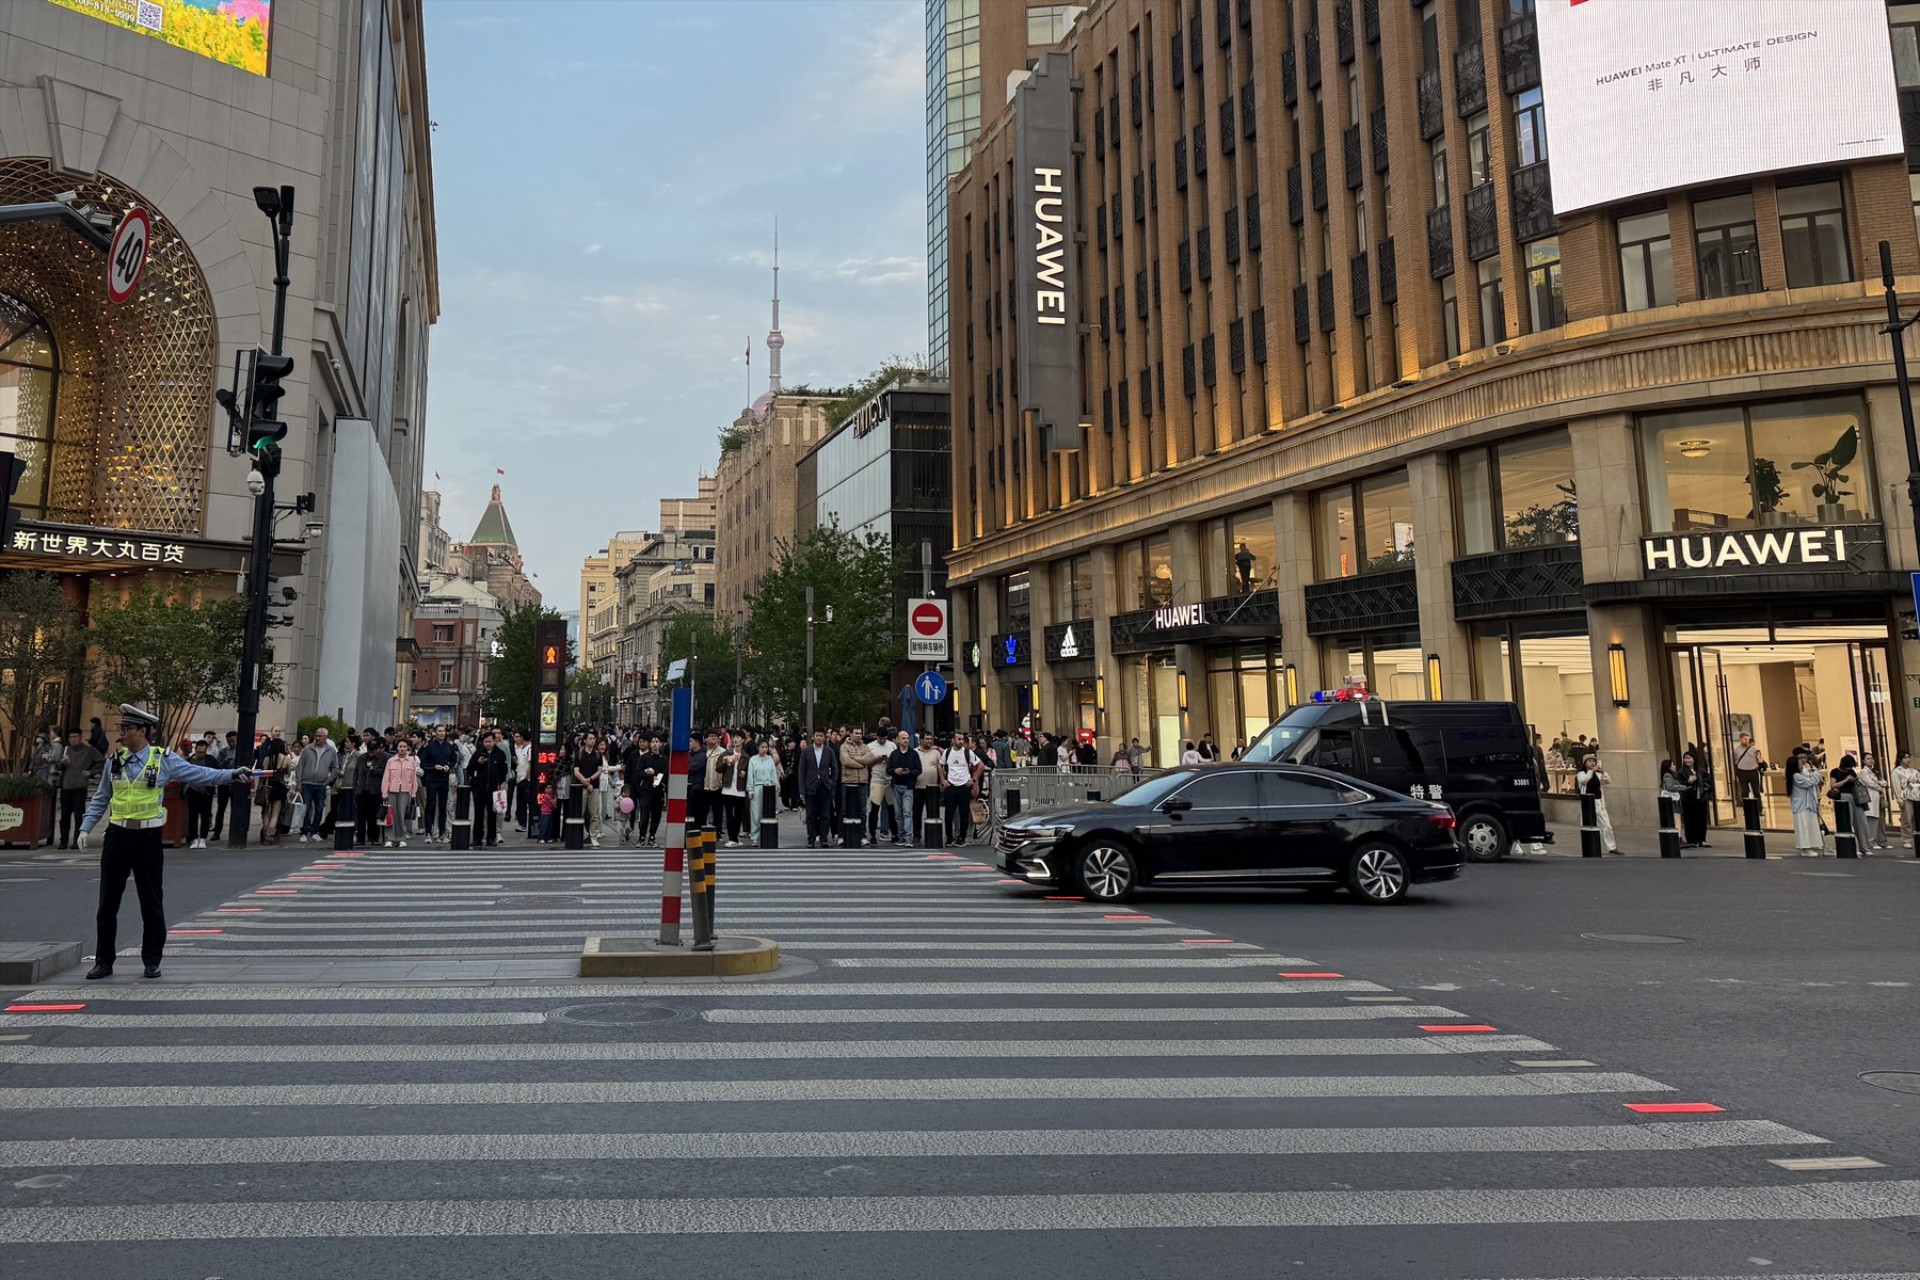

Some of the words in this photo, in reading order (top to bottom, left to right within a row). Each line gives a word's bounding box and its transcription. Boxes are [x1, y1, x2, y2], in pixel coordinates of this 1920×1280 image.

[1596, 68, 1642, 86] HUAWEI
[1645, 60, 1671, 72] Mate
[1674, 55, 1687, 65] XT
[1698, 41, 1760, 60] ULTIMATE
[1766, 31, 1818, 46] DESIGN
[1648, 56, 1761, 92] 非凡大师
[116, 231, 143, 284] 40
[1034, 168, 1065, 324] HUAWEI
[12, 530, 186, 563] 新世界大丸百货
[1645, 529, 1846, 570] HUAWEI
[1155, 603, 1203, 629] HUAWEI
[1410, 783, 1442, 799] 特警
